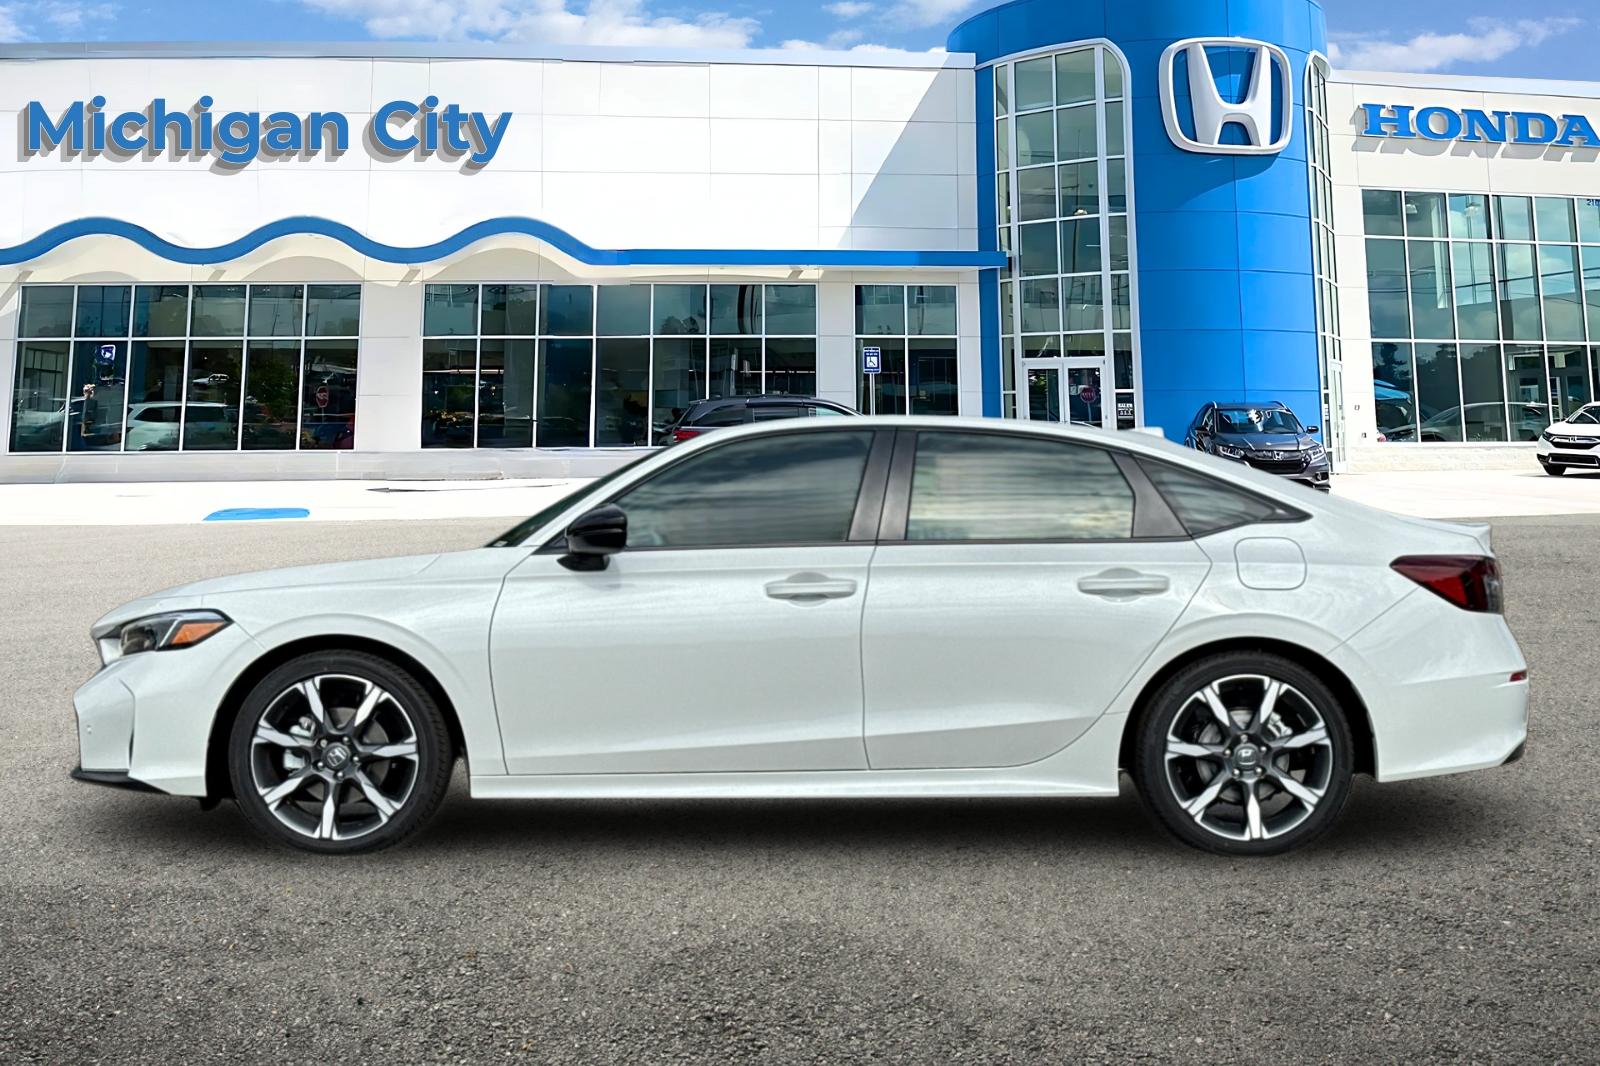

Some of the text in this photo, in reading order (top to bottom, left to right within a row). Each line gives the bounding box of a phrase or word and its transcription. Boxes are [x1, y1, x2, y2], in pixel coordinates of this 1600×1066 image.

[29, 95, 513, 164] Michigan City
[1361, 103, 1600, 147] HONDA
